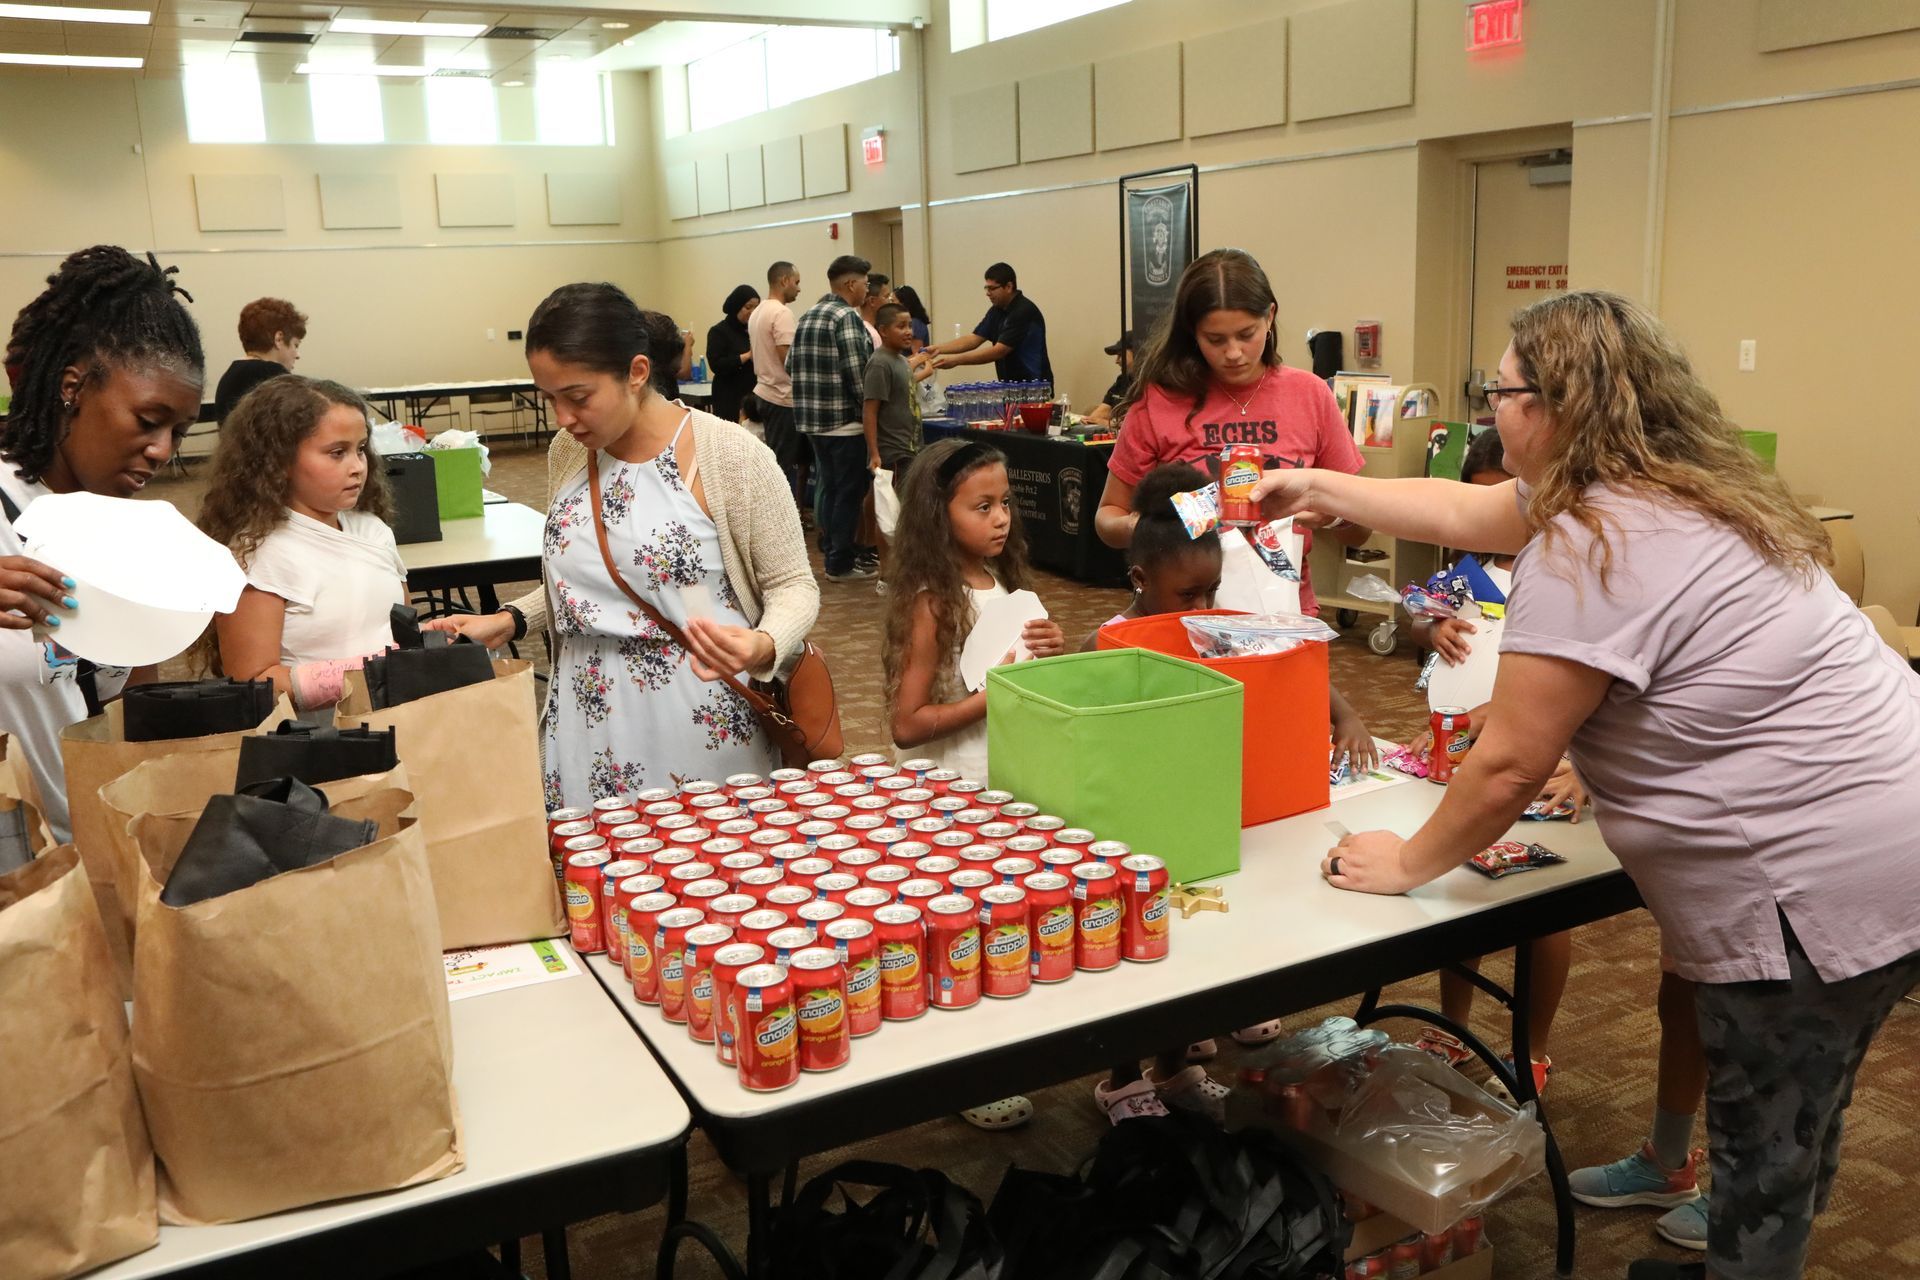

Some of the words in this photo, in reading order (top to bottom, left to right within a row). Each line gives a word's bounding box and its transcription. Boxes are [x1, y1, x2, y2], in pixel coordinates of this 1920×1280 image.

[1474, 1, 1517, 45] EXIT
[1506, 266, 1546, 276] EMERGENCY
[1548, 265, 1562, 275] EXIT
[1507, 280, 1530, 289] ALARM
[1535, 280, 1551, 289] WILL
[1202, 420, 1279, 447] ECHS
[1226, 473, 1259, 486] snapple
[987, 935, 1028, 955] snapple
[881, 954, 916, 970] napple
[798, 998, 841, 1019] snapple
[761, 1057, 785, 1067] orange
